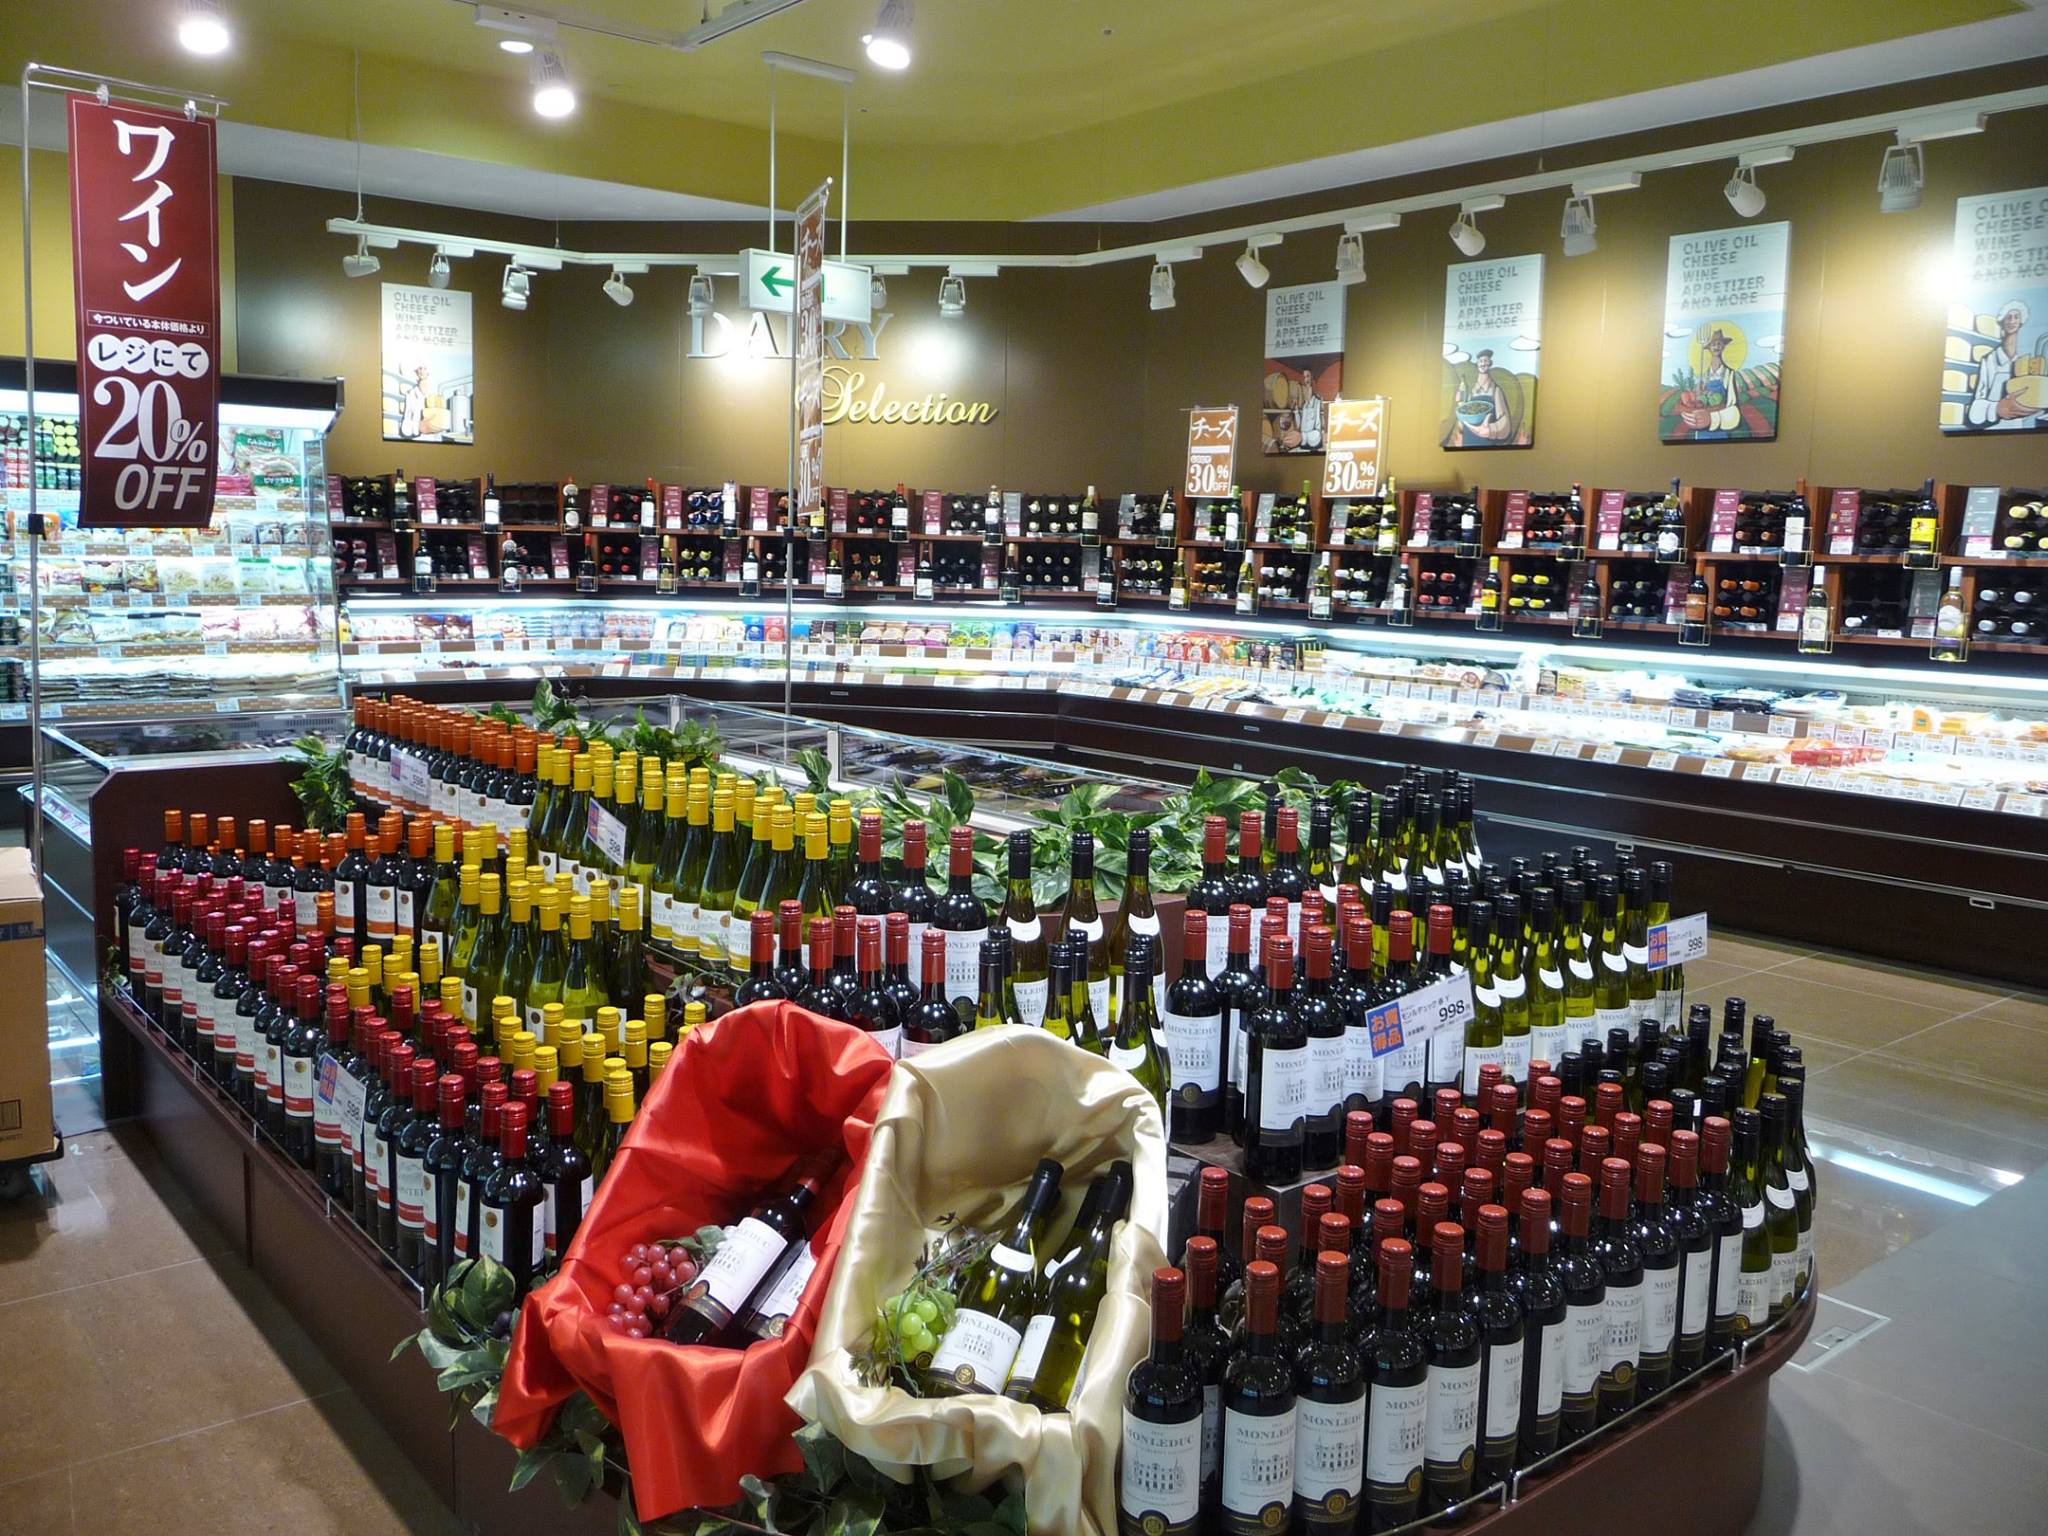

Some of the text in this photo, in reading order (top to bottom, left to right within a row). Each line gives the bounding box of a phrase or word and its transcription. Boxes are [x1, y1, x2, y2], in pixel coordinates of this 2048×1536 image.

[113, 119, 182, 301] ワイン
[1976, 201, 2032, 220] OLIVE
[1975, 215, 2045, 236] CHEESE
[1683, 235, 1758, 255] OLIVE OIL
[1682, 251, 1737, 269] CHEESE
[1459, 266, 1518, 283] OLIVE OIL
[1683, 267, 1719, 282] WINE
[1458, 280, 1502, 294] CHEESE
[1682, 276, 1765, 296] APPETIZER
[394, 292, 451, 306] OLIVE OIL
[1276, 290, 1324, 305] OLIVE OIL
[1459, 295, 1487, 307] WINE
[1681, 292, 1758, 310] AND MORE
[394, 303, 436, 315] CHEESE
[1275, 303, 1311, 316] CHEESE
[1458, 302, 1523, 319] APPETIZER
[92, 313, 205, 335] 今ついている本体価格より
[395, 313, 422, 324] WINE
[396, 324, 458, 337] APPETIZER
[1276, 323, 1328, 338] APPETIZER
[98, 341, 203, 371] レジにて
[796, 366, 998, 425] Selection
[94, 376, 207, 463] 20%
[1192, 416, 1236, 440] チーズ
[1330, 407, 1381, 435] チーズ
[1189, 463, 1229, 492] 30%
[1326, 460, 1375, 493] 30%
[1355, 481, 1375, 490] OFF
[115, 464, 206, 510] OFF
[1212, 482, 1228, 491] OFF
[1688, 936, 1703, 951] 998
[1439, 1000, 1465, 1022] 998
